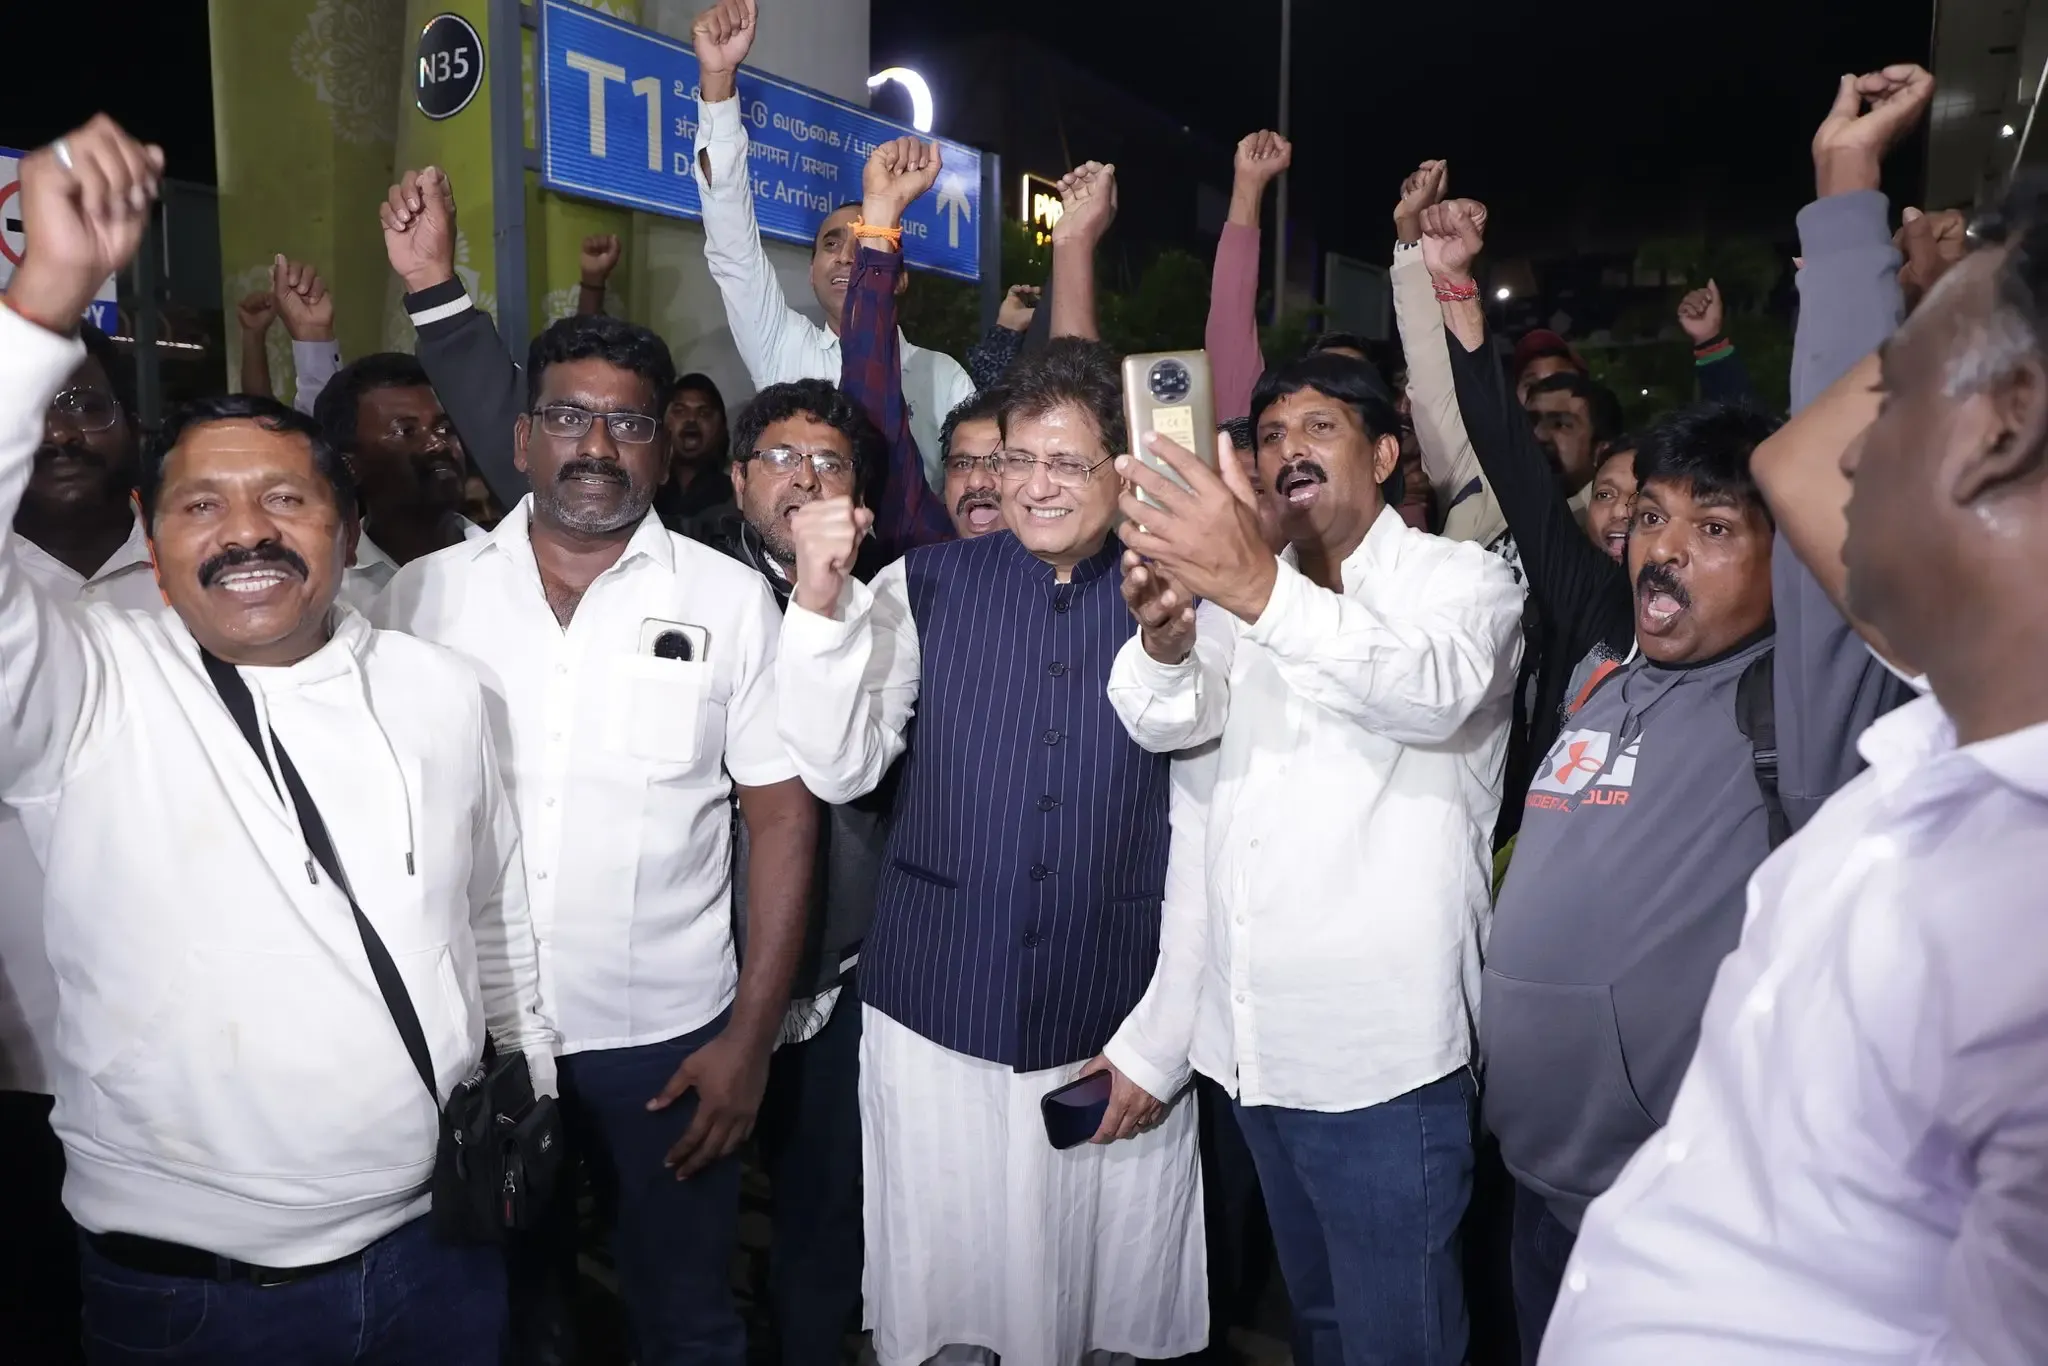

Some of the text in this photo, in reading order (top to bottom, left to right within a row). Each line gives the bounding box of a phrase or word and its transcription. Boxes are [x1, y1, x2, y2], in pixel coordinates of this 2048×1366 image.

[420, 47, 469, 88] N35
[566, 49, 663, 172] T1
[773, 112, 840, 147] வருகை
[774, 180, 833, 214] Arrival
